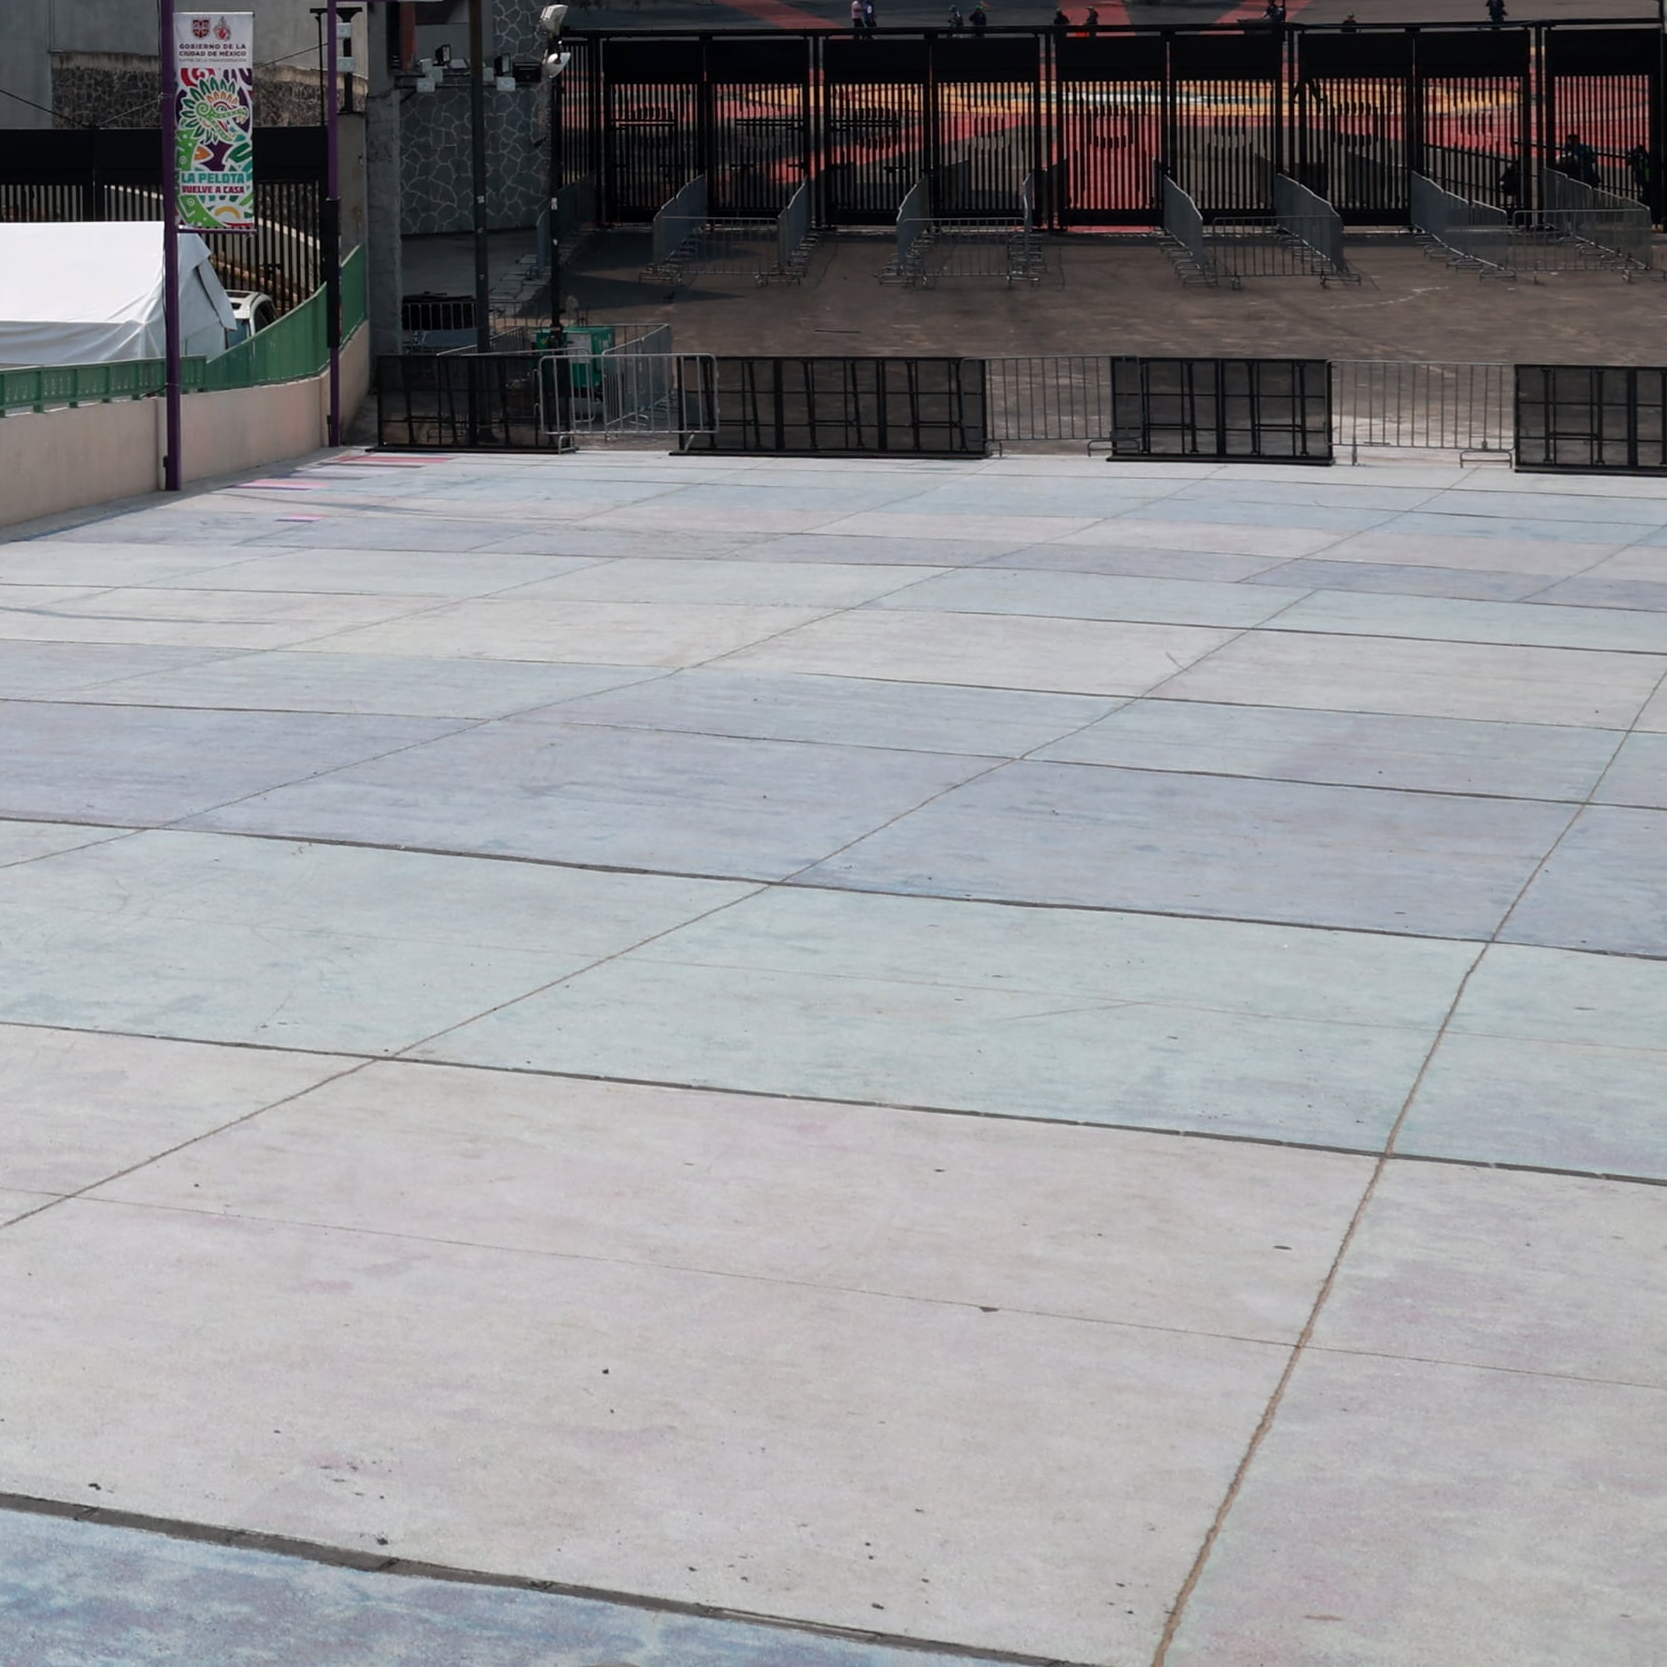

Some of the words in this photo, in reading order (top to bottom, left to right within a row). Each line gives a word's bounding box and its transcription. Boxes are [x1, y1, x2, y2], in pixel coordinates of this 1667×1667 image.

[181, 173, 195, 184] LA
[198, 173, 245, 184] PELOTA
[181, 186, 213, 194] VUELVE
[215, 186, 221, 194] A
[223, 186, 245, 194] CASA
